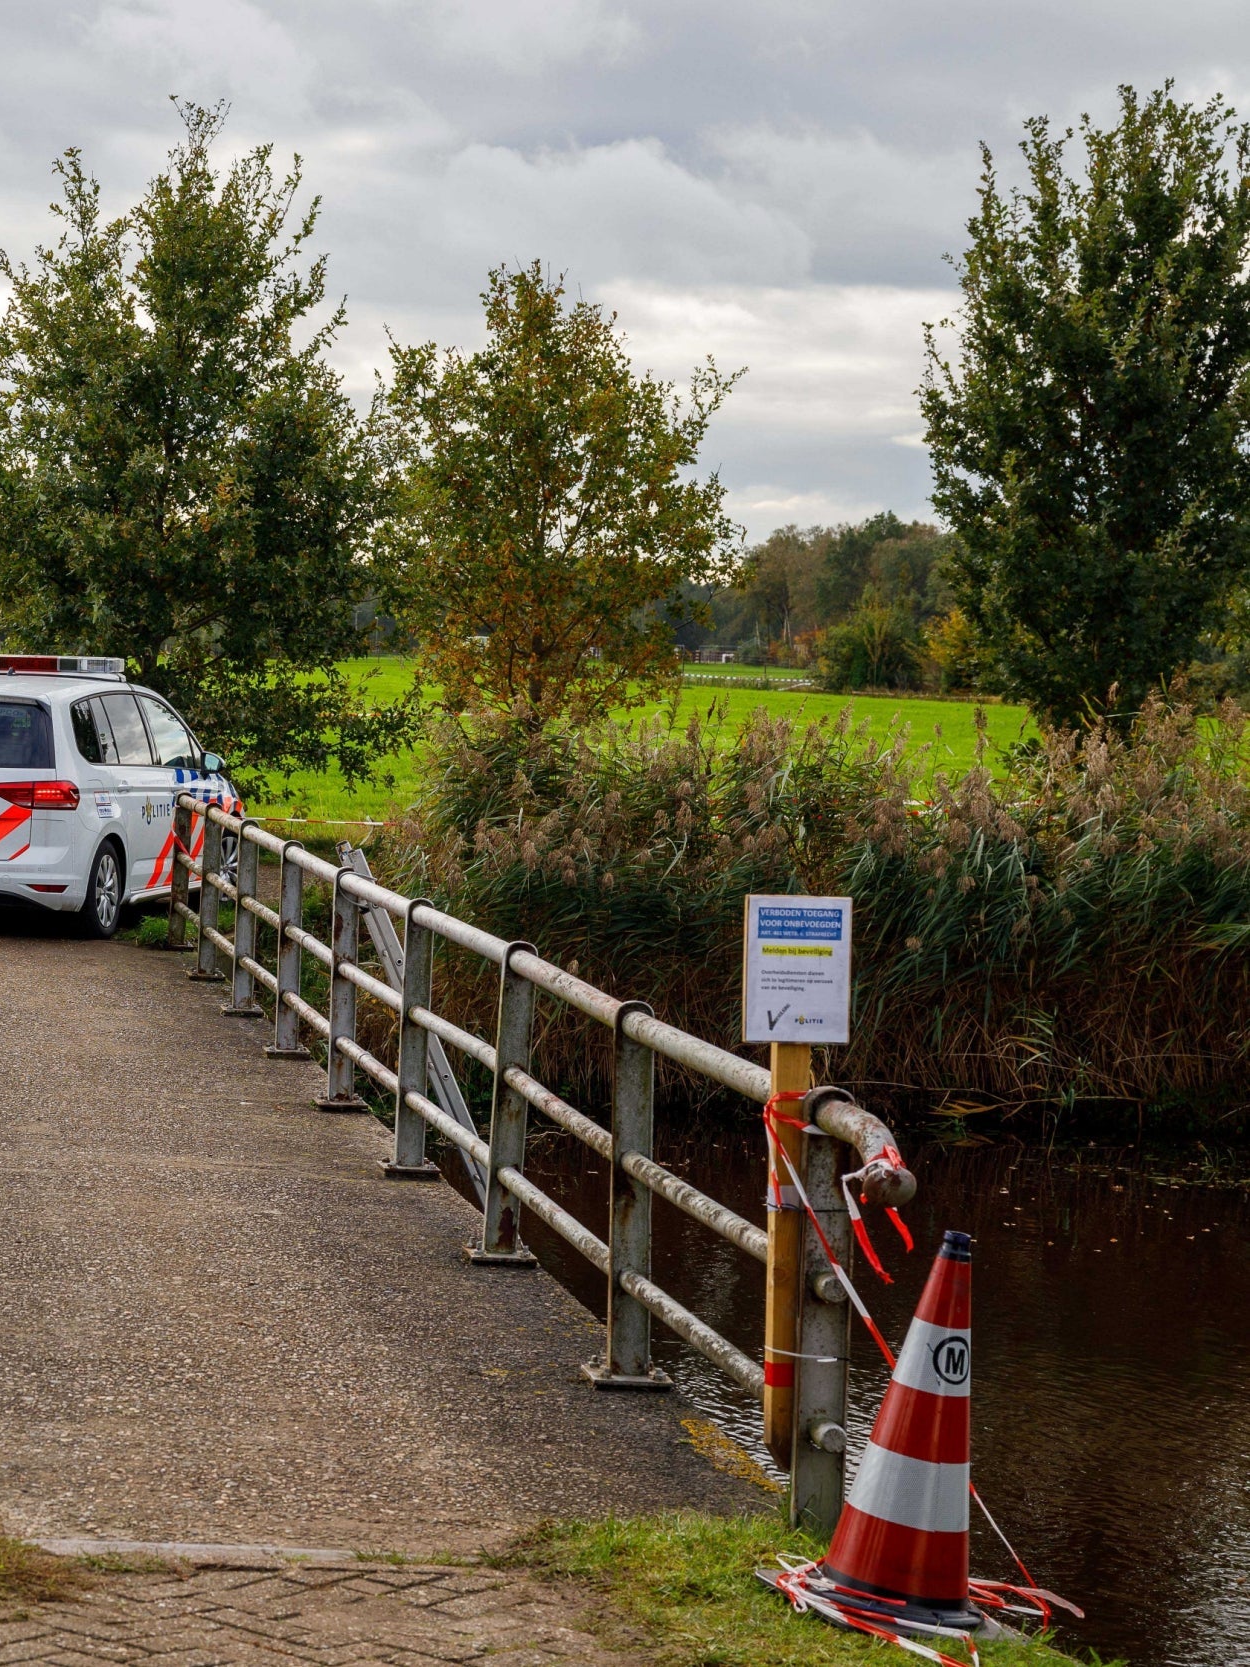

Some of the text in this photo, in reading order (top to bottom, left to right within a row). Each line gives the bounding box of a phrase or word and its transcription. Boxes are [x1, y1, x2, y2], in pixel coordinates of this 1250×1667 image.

[141, 799, 170, 825] POLITIE
[760, 908, 840, 918] VERBODEN TOEGANG
[760, 919, 841, 929] VOOR ONBEVOEGDEN
[945, 1347, 966, 1376] M
